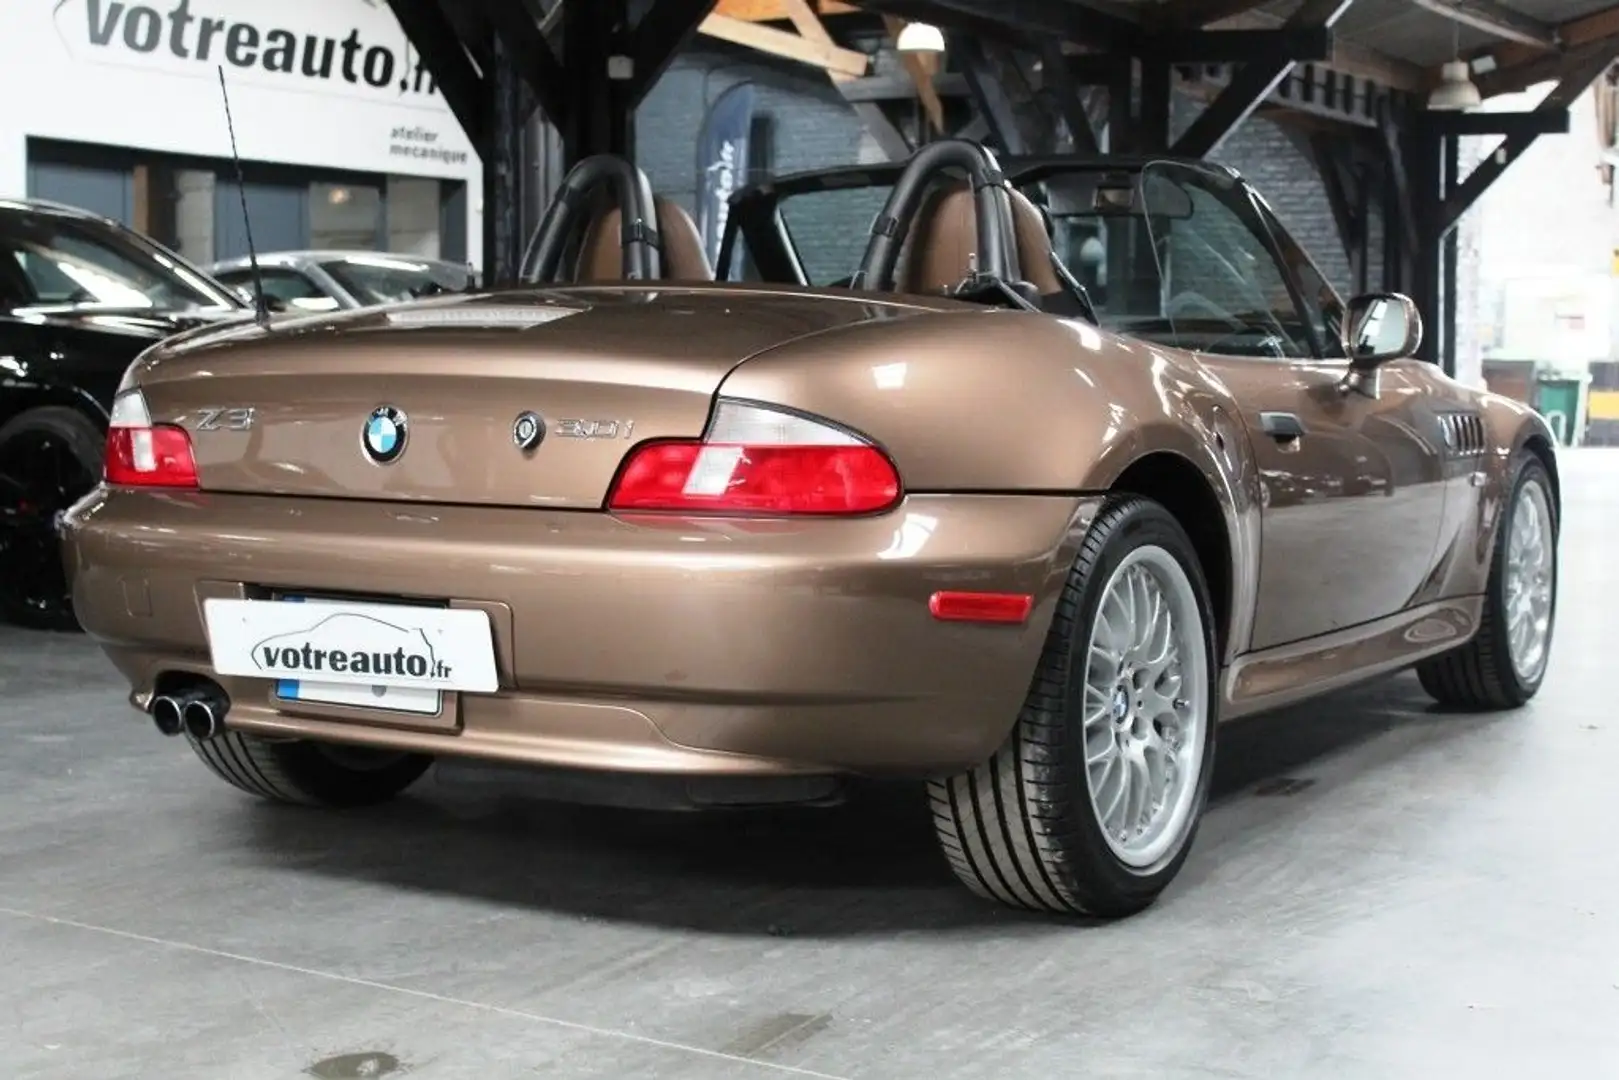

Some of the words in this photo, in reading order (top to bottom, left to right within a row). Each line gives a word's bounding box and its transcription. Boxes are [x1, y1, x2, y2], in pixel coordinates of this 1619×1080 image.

[390, 126, 439, 142] atelier
[197, 407, 255, 435] Z3
[263, 642, 452, 678] votreauto.fr
